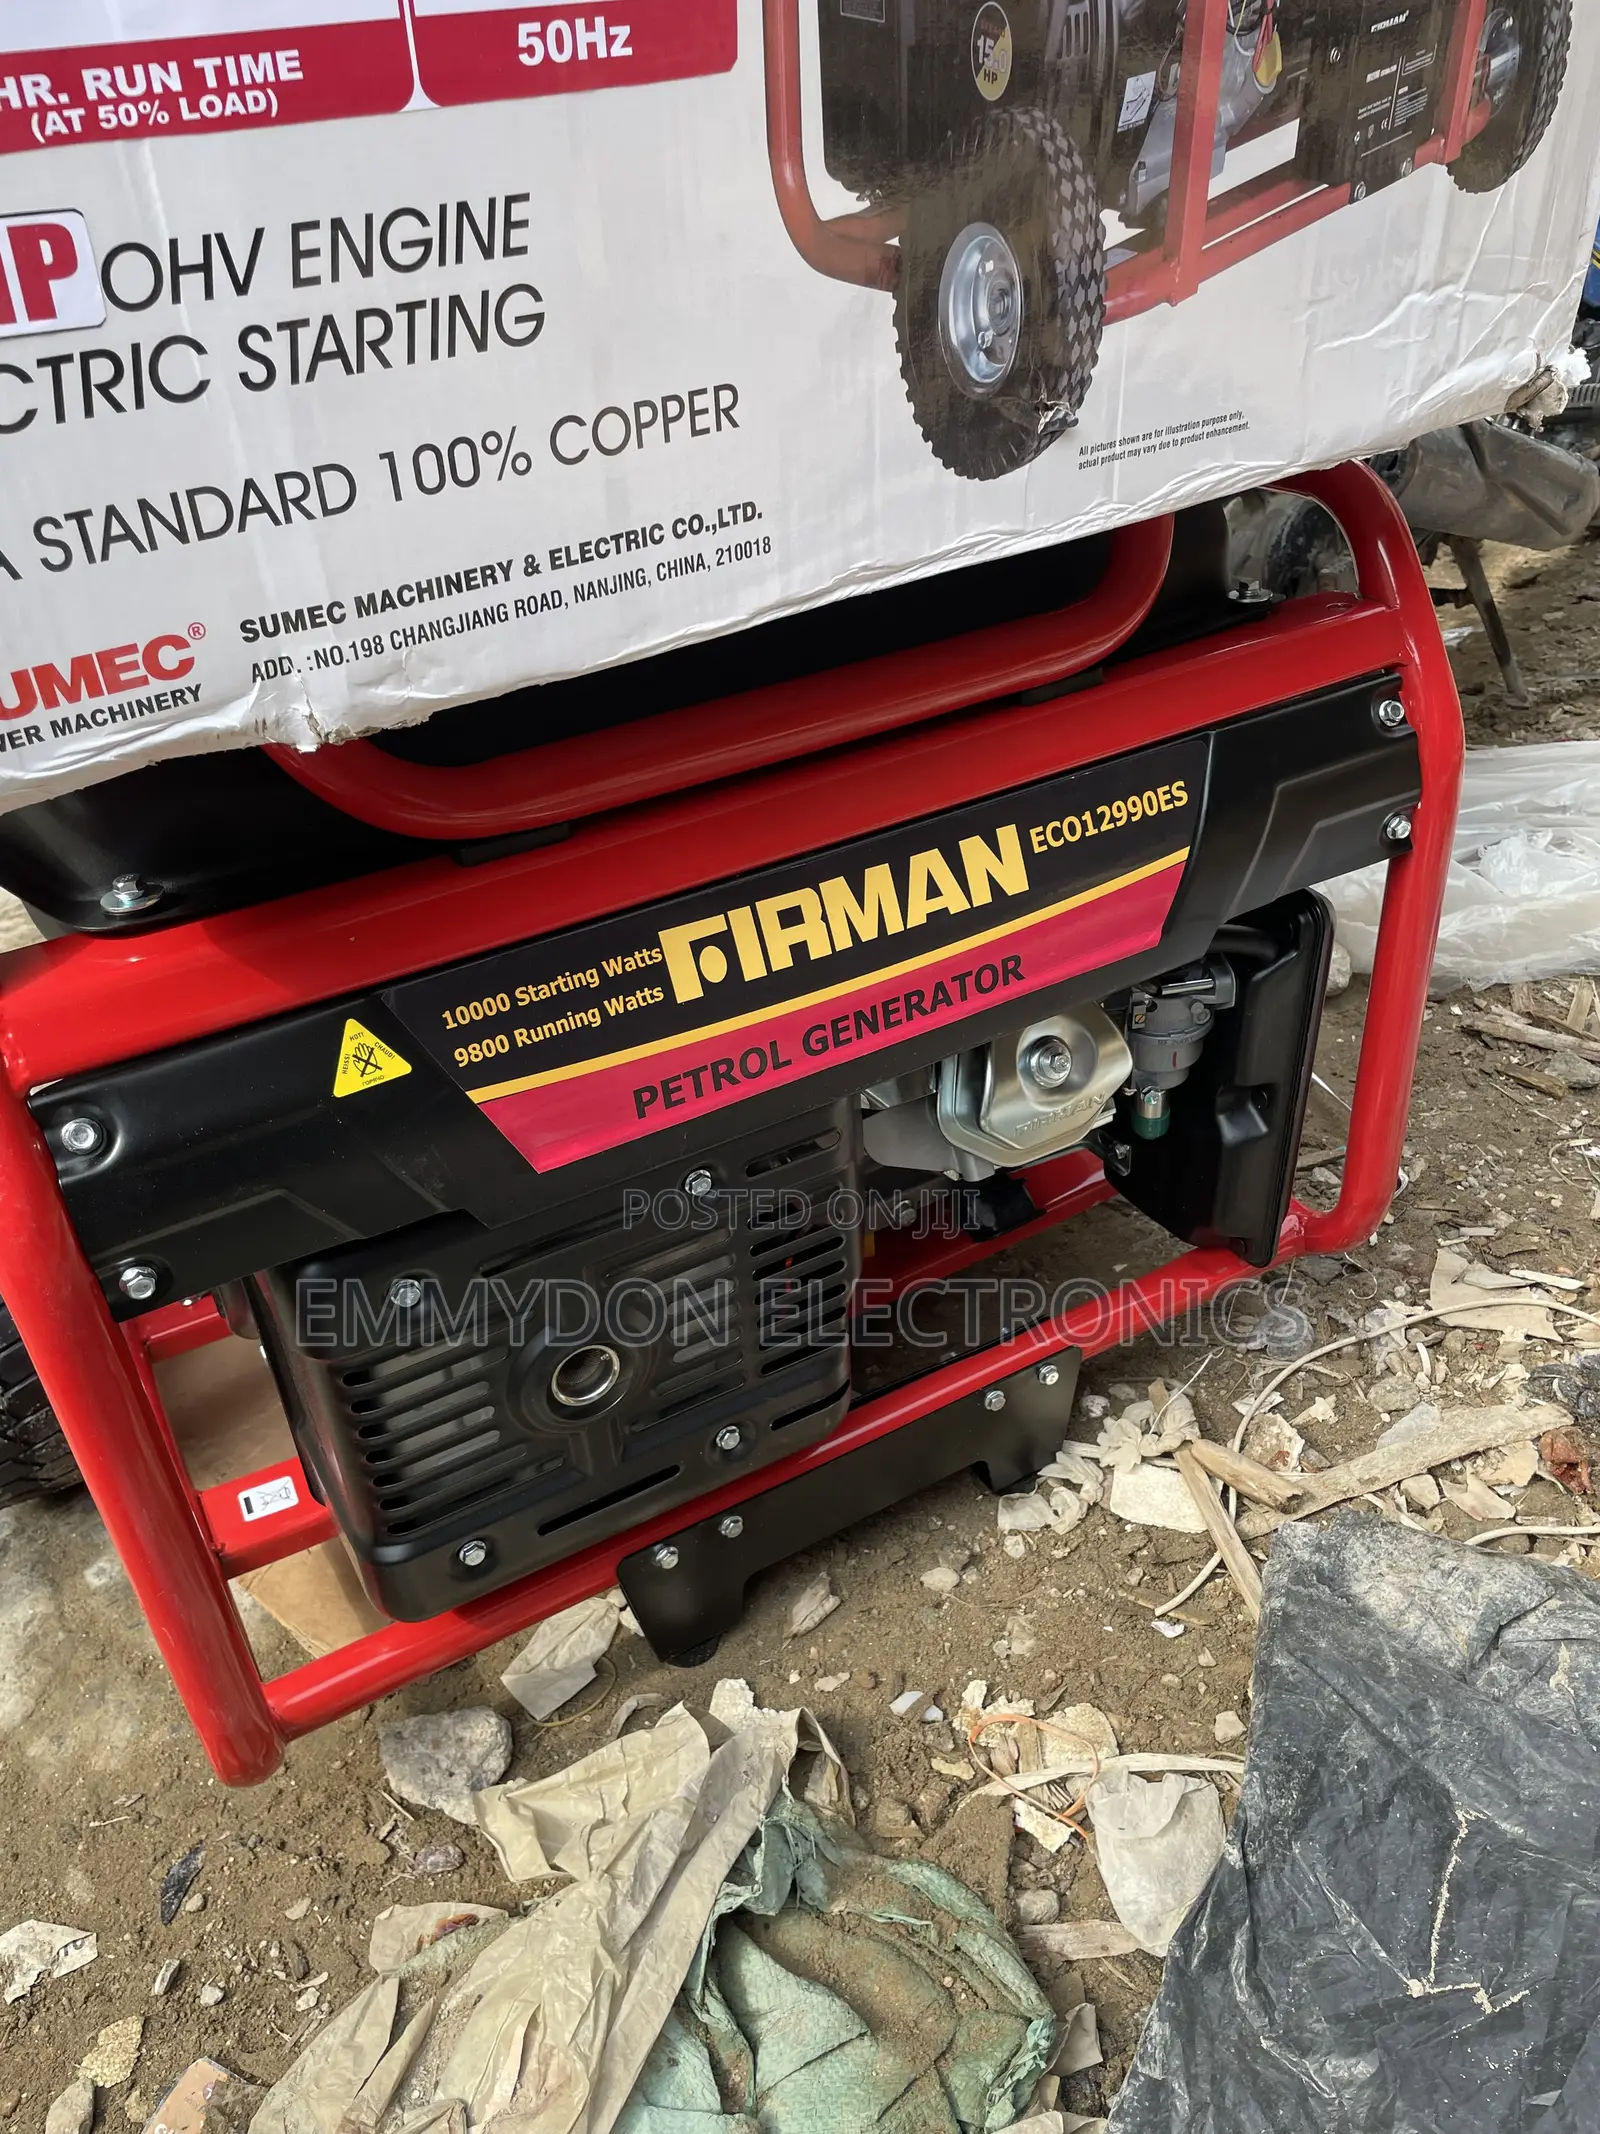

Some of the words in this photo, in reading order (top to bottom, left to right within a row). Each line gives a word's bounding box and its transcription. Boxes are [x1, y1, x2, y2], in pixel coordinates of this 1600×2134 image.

[81, 61, 183, 101] RUN
[193, 49, 304, 89] TIME
[517, 17, 634, 67] 50Hz
[983, 68, 998, 84] HP
[31, 108, 86, 144] (AT
[97, 99, 170, 130] 50%
[179, 88, 279, 121] LOAD)
[0, 222, 78, 324] P
[101, 227, 265, 312] OHV
[290, 192, 531, 289] ENGINE
[0, 334, 211, 434] CTRIC
[237, 283, 546, 393] STARTING
[33, 464, 357, 573] STANDARD
[379, 425, 533, 503] 100%
[550, 382, 741, 466] COPPER
[1078, 446, 1089, 457] All
[1090, 440, 1117, 455] pictures
[1118, 435, 1140, 447] shown
[1141, 432, 1153, 442] are
[1154, 429, 1164, 439] for
[1165, 420, 1200, 436] illustration
[1201, 414, 1228, 430] purpose
[1078, 458, 1099, 470] actual
[1100, 452, 1126, 466] product
[1127, 448, 1142, 459] may
[1142, 444, 1157, 456] vary
[1158, 441, 1171, 451] due
[1172, 439, 1179, 447] to
[1180, 432, 1205, 447] product
[1206, 421, 1251, 440] enhancement.
[240, 601, 347, 643] SUMEC
[354, 559, 513, 619] MACHINERY
[523, 554, 542, 577] &
[549, 523, 664, 571] ELECTRIC
[672, 501, 763, 539] CO.,LTD.
[390, 602, 509, 650] CHANGJIANG
[514, 589, 569, 618] ROAD,
[573, 568, 652, 604] NANJING,
[656, 552, 711, 582] CHINA,
[716, 536, 772, 567] 210018
[50, 683, 202, 738] MACHINERY
[658, 823, 1030, 1005] FIRMAN
[1030, 780, 1189, 855] ECO12990ES
[441, 993, 512, 1030] 10000
[515, 963, 601, 1010] Starting
[603, 944, 663, 979] Watts
[453, 1034, 510, 1068] 9800
[515, 1005, 602, 1048] Running
[603, 982, 664, 1020] Watts
[632, 1042, 791, 1120] PETROL
[802, 953, 1025, 1056] GENERATOR
